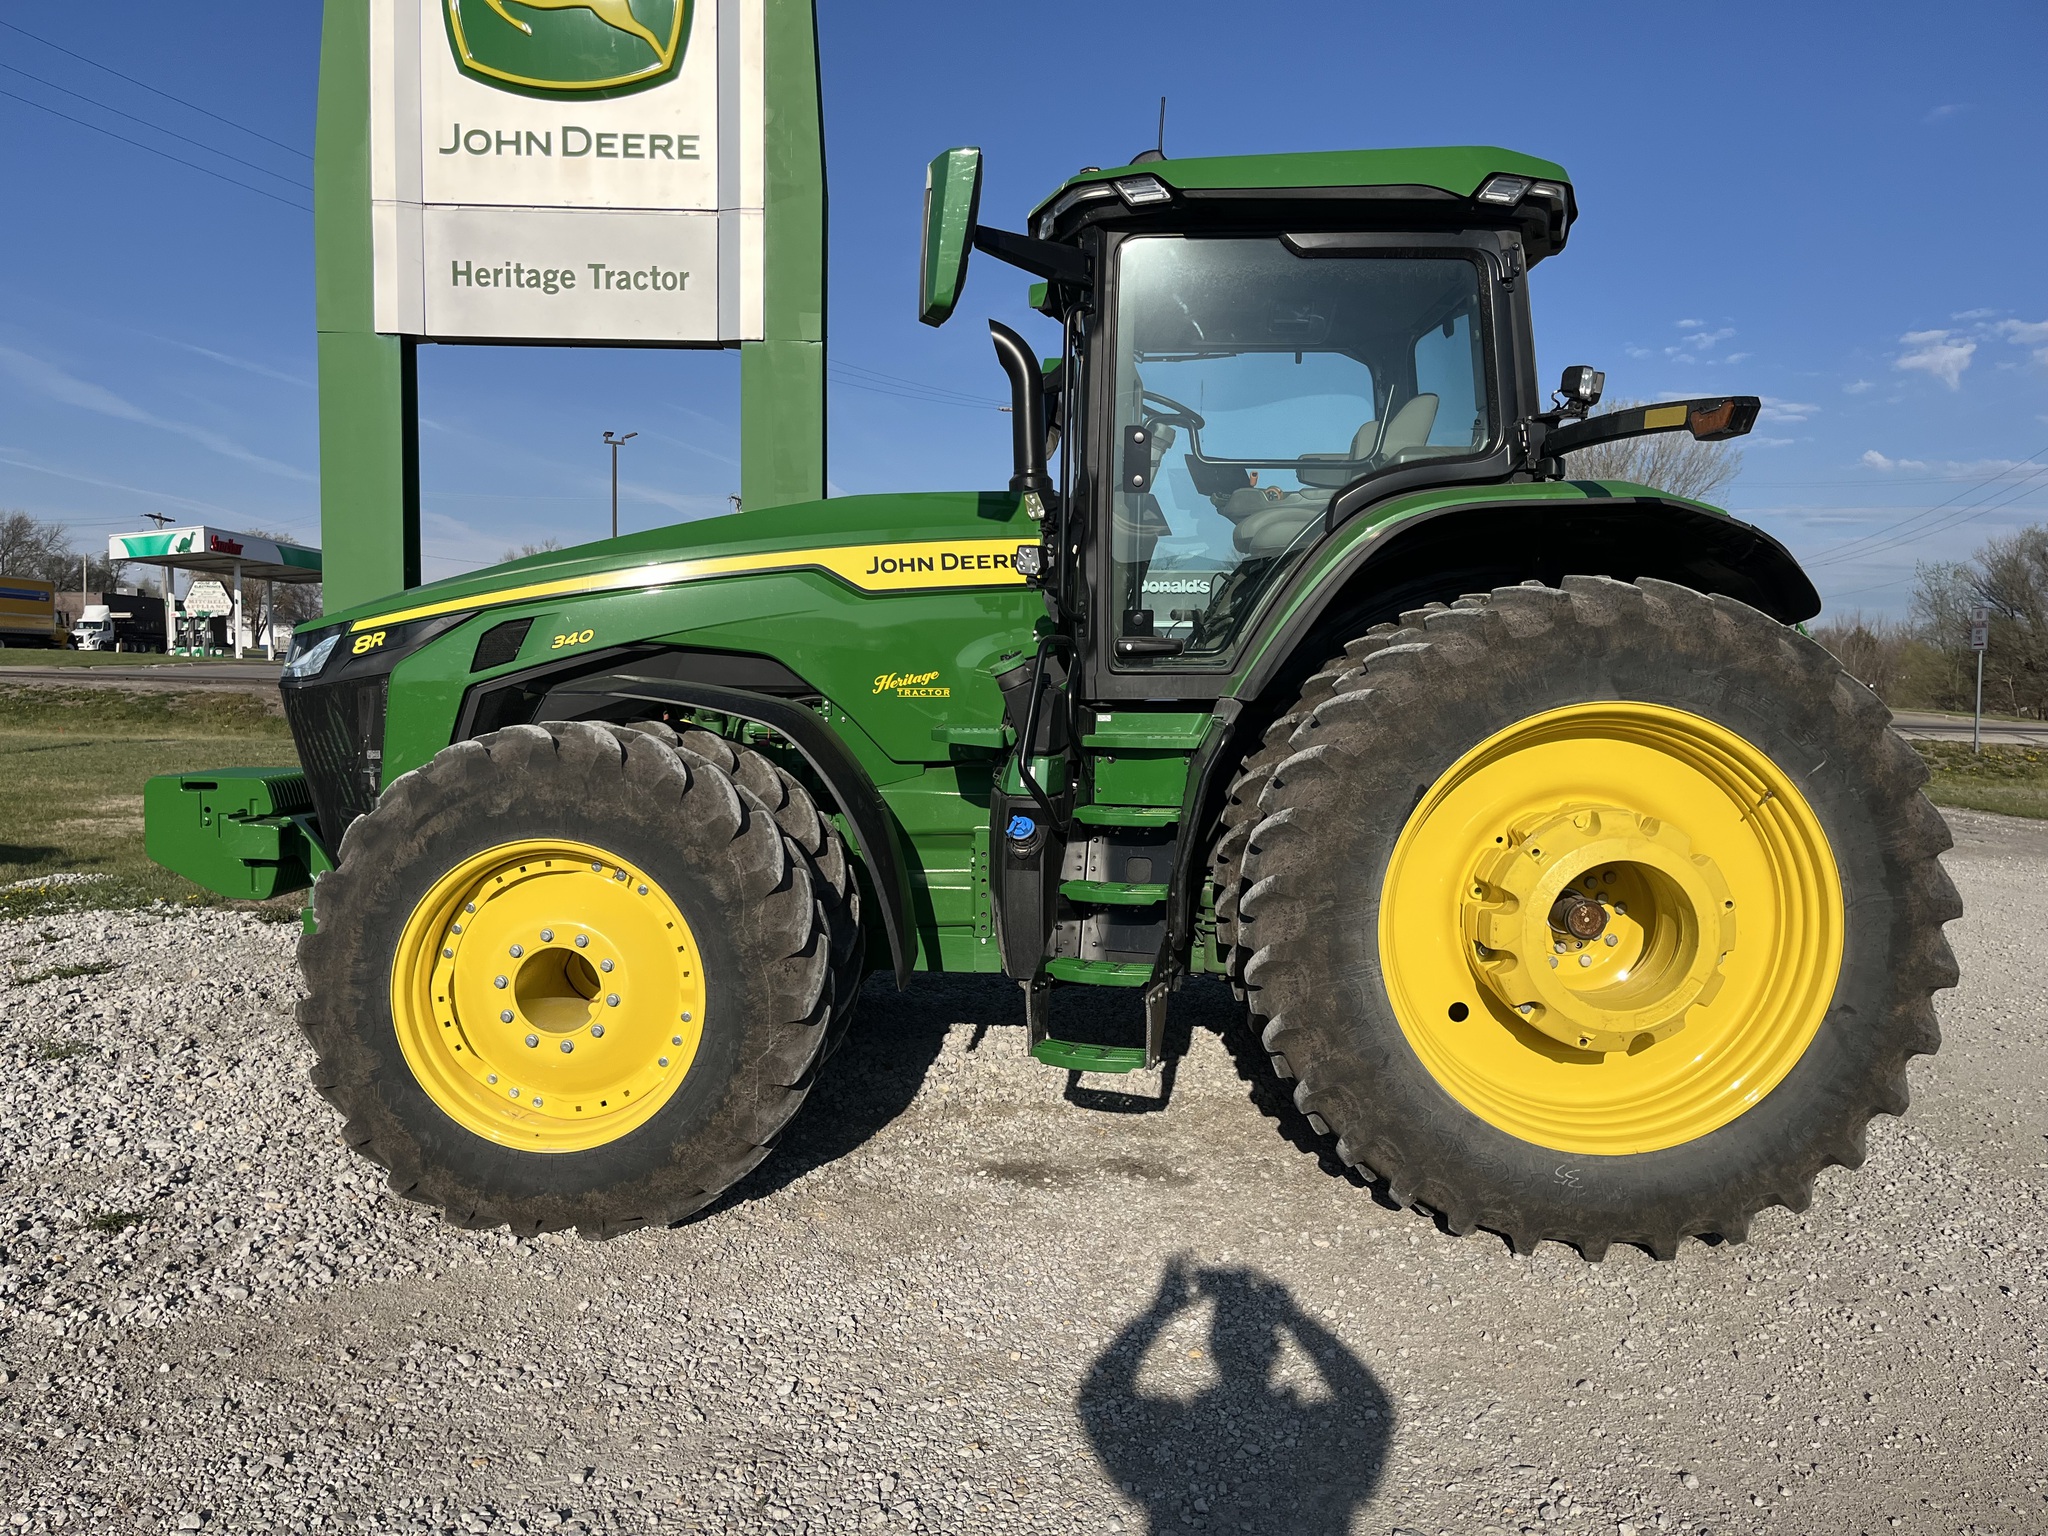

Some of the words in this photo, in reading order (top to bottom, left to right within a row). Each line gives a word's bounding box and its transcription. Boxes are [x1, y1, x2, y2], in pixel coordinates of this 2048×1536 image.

[438, 122, 552, 157] JOHN
[561, 125, 700, 160] DEERE
[451, 260, 576, 295] Heritage
[587, 263, 690, 291] Tractor
[866, 556, 934, 574] JOHN
[352, 631, 387, 654] 8R
[551, 629, 595, 649] 340
[872, 670, 940, 694] Heritage
[897, 688, 950, 697] TRACTOR
